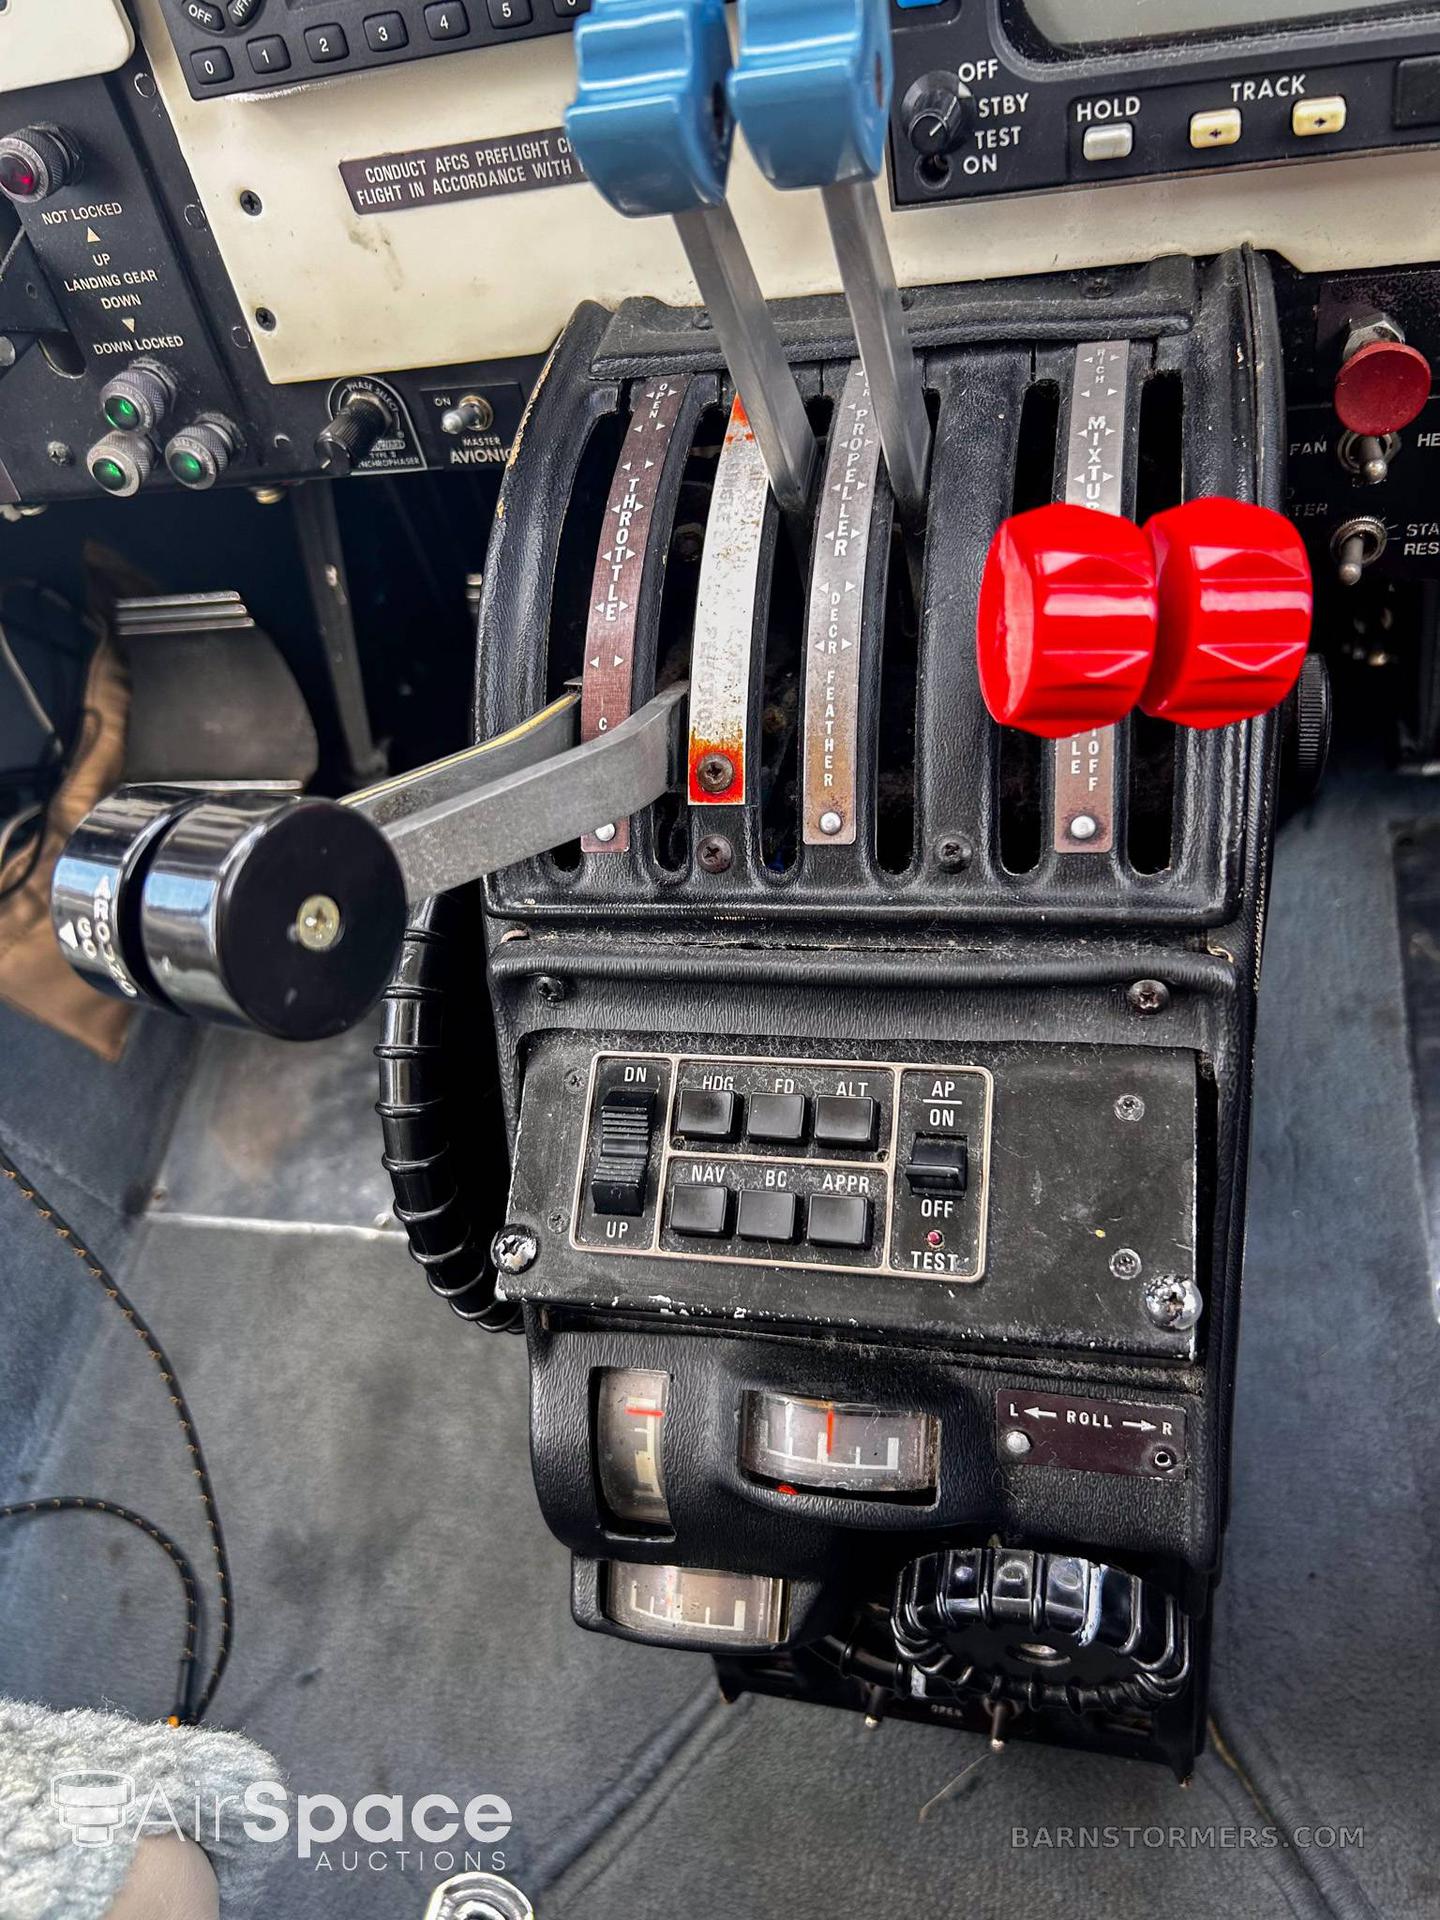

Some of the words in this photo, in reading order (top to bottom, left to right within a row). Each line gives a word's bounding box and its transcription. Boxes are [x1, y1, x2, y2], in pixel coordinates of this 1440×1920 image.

[188, 4, 213, 24] OFF
[502, 2, 512, 18] 5
[440, 15, 449, 30] 4
[378, 26, 389, 42] 3
[319, 37, 329, 53] 2
[261, 49, 270, 64] 1
[204, 60, 215, 75] 0
[958, 59, 999, 82] OFF
[1230, 74, 1307, 102] TRACK
[978, 92, 1029, 118] STBY
[1075, 96, 1141, 122] HOLD
[974, 126, 1022, 150] TEST
[364, 160, 427, 184] CONDUCT
[436, 155, 470, 174] AFCS
[477, 140, 549, 167] PREFLIGHT
[963, 153, 998, 174] ON
[356, 187, 402, 206] FLIGHT
[409, 182, 425, 198] IN
[433, 166, 526, 195] ACCORDANCE
[534, 158, 572, 180] WITH
[41, 210, 68, 225] NOT
[71, 202, 123, 221] LOCKED
[92, 253, 111, 267] UP
[63, 274, 122, 292] LANDING
[123, 269, 158, 284] GEAR
[101, 294, 142, 309] DOWN
[93, 340, 134, 355] DOWN
[134, 335, 184, 351] LOCKED
[346, 381, 373, 392] PHASE
[434, 397, 451, 407] ON
[650, 383, 668, 419] OPEN
[462, 437, 501, 447] MASTER
[1289, 440, 1327, 456] FAN
[833, 409, 869, 557] PROPELLER
[605, 478, 640, 622] THROTTLE
[828, 592, 841, 655] DECR
[823, 671, 836, 787] FEATHER
[77, 916, 97, 960] GO
[624, 1065, 647, 1083] DN
[702, 1074, 734, 1091] HDG
[774, 1078, 794, 1094] FD
[836, 1081, 869, 1097] ALT
[932, 1080, 951, 1098] AP
[929, 1108, 955, 1128] ON
[691, 1166, 726, 1183] NAV
[765, 1170, 788, 1188] BC
[822, 1174, 870, 1194] APPR
[920, 1200, 954, 1219] OFF
[605, 1221, 629, 1240] UP
[910, 1251, 957, 1271] TEST
[1009, 1403, 1020, 1418] L
[1065, 1410, 1113, 1431] ROLL
[1161, 1421, 1174, 1436] R
